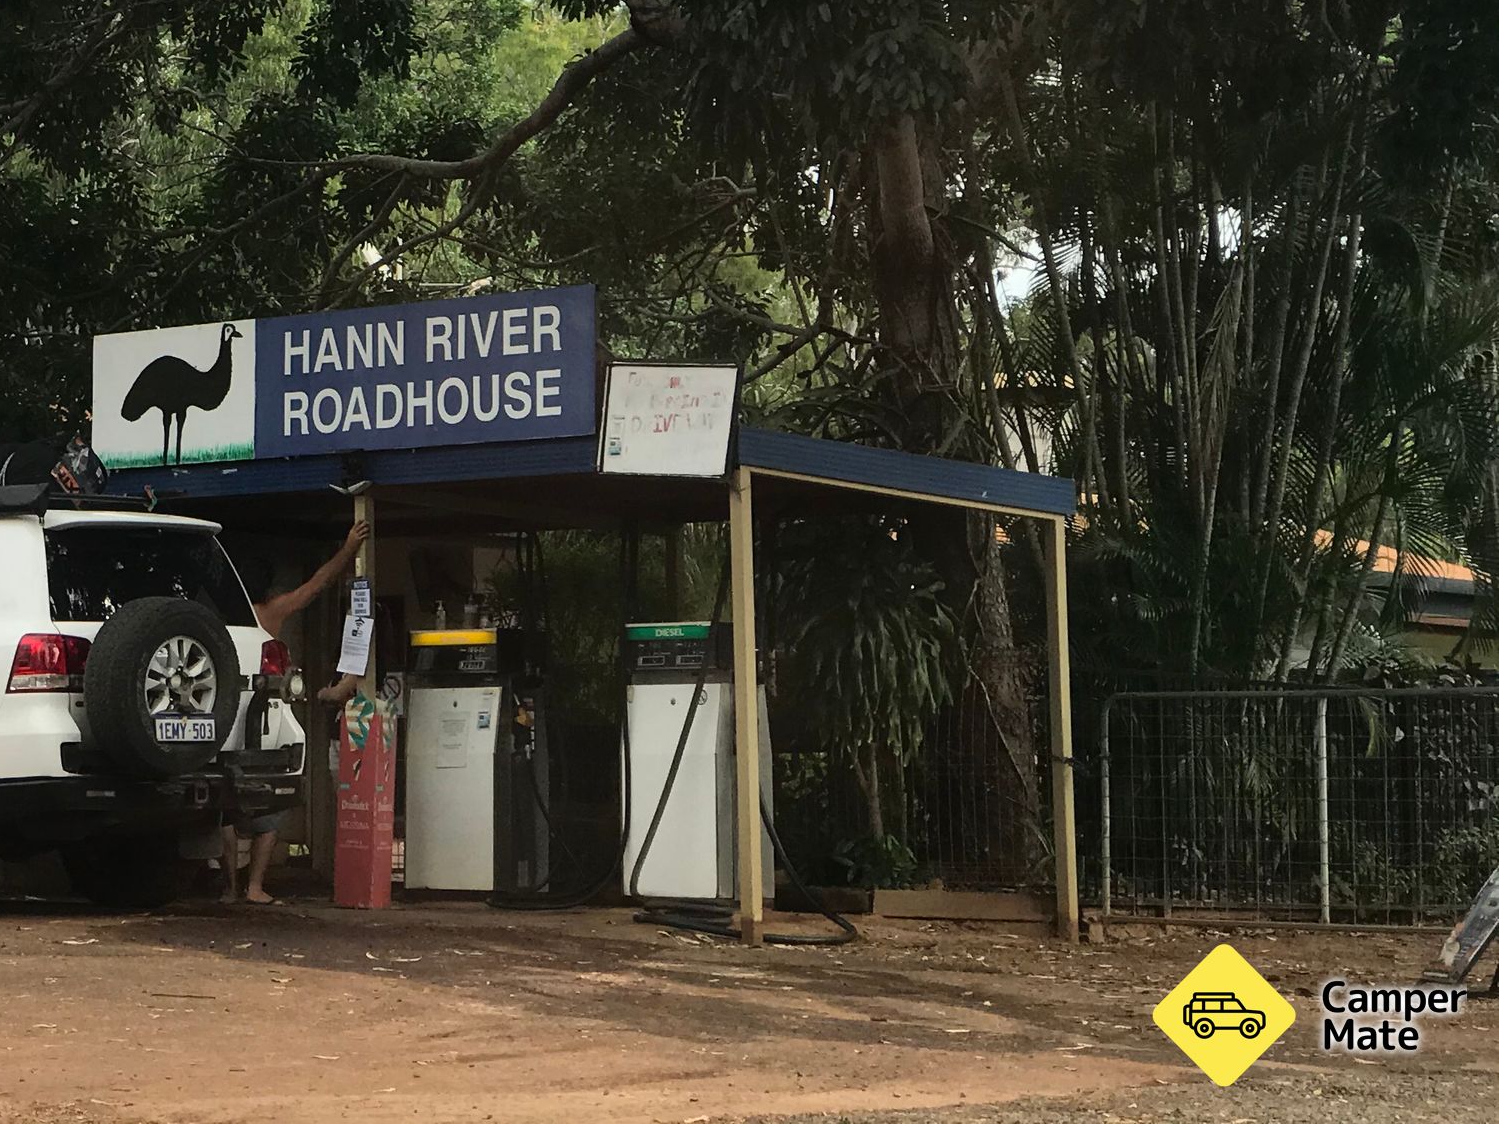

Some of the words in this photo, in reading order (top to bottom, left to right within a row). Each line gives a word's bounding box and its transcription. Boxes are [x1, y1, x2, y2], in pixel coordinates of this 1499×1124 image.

[284, 320, 404, 375] HANN
[425, 305, 562, 363] RIVER
[284, 369, 562, 436] ROADHOUSE
[655, 628, 684, 637] DIESEL
